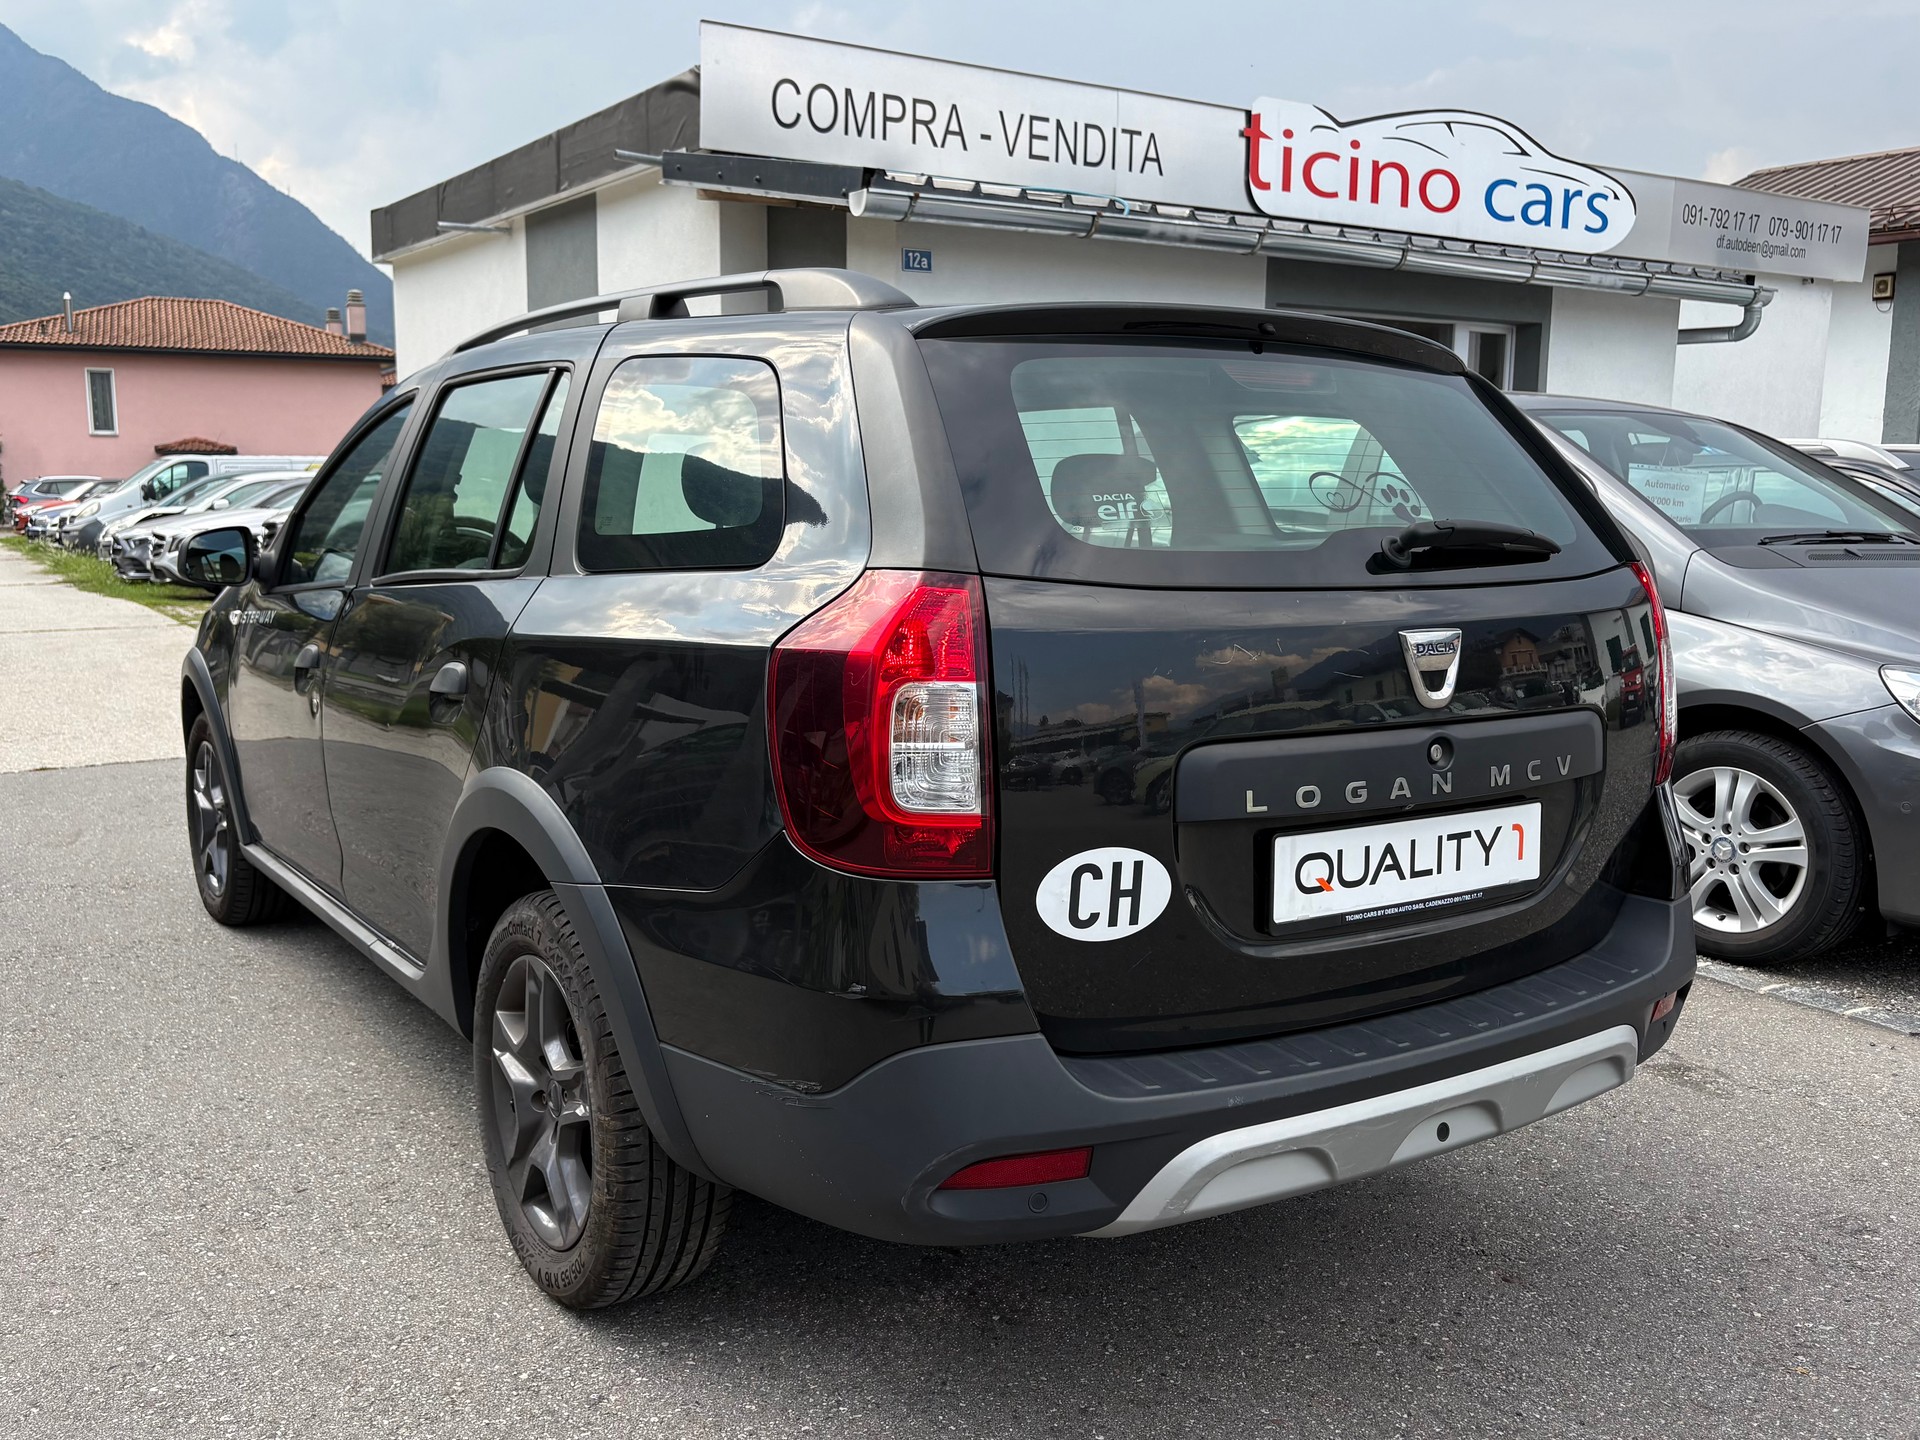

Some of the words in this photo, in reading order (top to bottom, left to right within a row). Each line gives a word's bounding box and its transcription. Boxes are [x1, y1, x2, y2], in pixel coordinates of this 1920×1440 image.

[771, 78, 968, 152] COMPRA
[999, 110, 1164, 177] VENDITA
[1243, 112, 1461, 214] ticino
[1484, 178, 1610, 235] cars
[1682, 203, 1730, 230] 091-792
[1733, 211, 1746, 232] 17
[1749, 213, 1760, 234] 17
[1768, 216, 1814, 241] 079-901
[1716, 234, 1806, 259] df.autodeen@gmail.com
[908, 252, 928, 269] 12a
[1092, 493, 1136, 502] DACIA
[1644, 479, 1690, 492] Automatico
[1097, 501, 1138, 521] elf
[1672, 496, 1685, 507] km
[241, 610, 277, 624] STEPWAY
[1416, 642, 1456, 654] DACIA
[1246, 770, 1453, 814] LOGAN
[1489, 753, 1572, 788] MCV
[1295, 825, 1502, 895] QUALITY
[1068, 859, 1144, 930] CH
[1345, 913, 1363, 922] TICINO
[1399, 905, 1412, 913] AUTO
[1425, 897, 1454, 908] CADENAZZO
